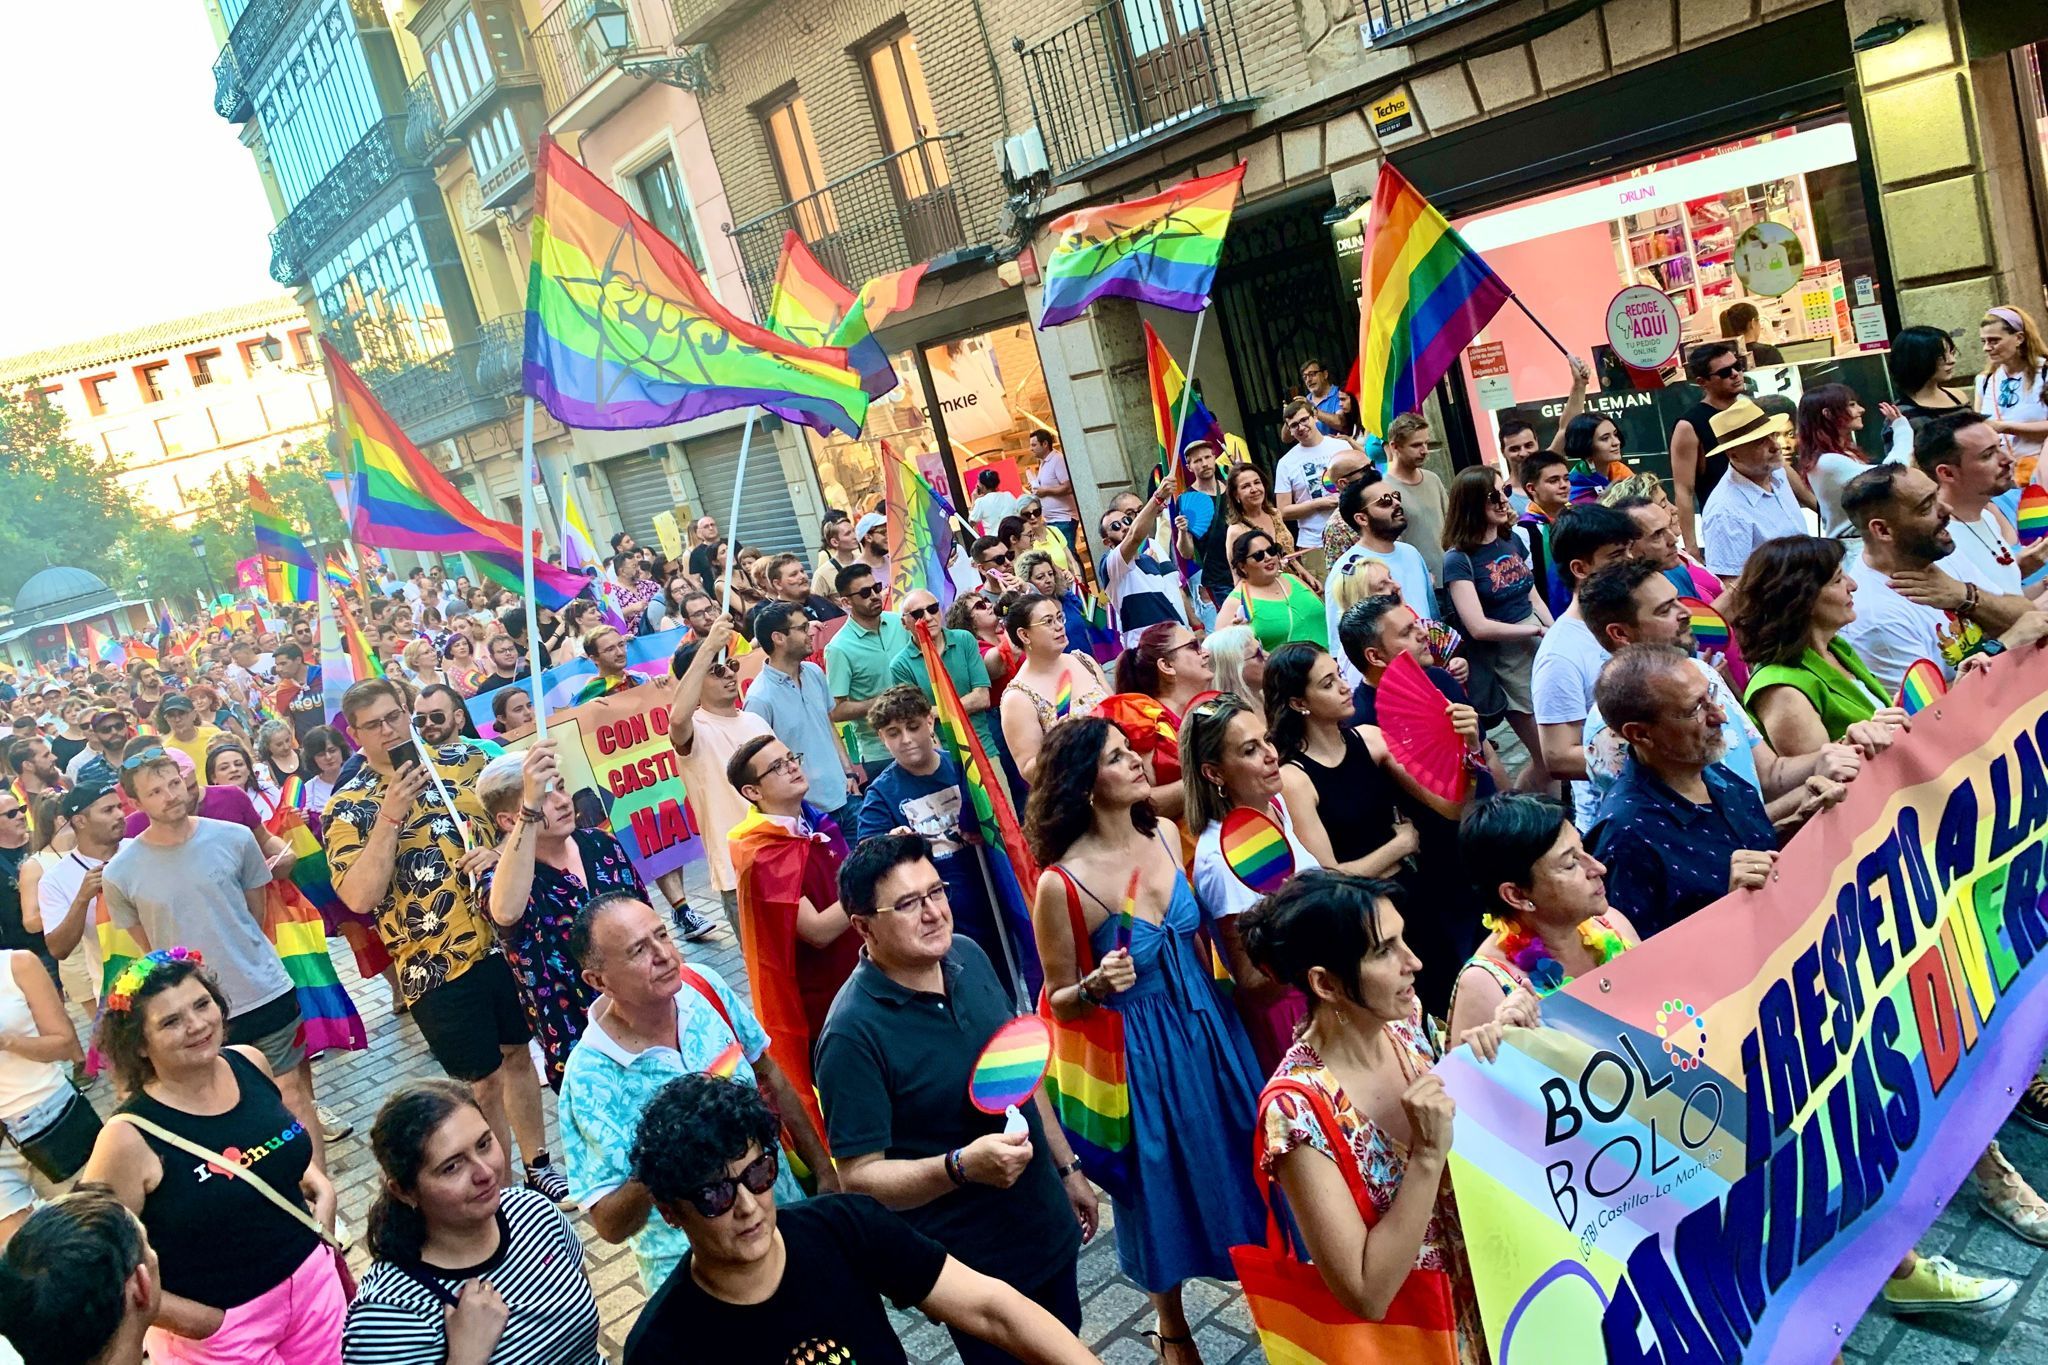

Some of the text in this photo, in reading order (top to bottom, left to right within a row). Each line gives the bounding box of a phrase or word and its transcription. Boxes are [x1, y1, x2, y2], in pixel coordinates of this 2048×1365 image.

[1618, 185, 1656, 204] DRUNI
[1625, 301, 1660, 317] RECOGE
[1634, 309, 1668, 339] AQUÍ
[1633, 347, 1658, 356] ONLINE
[1636, 338, 1661, 348] PEDIDO
[1541, 392, 1652, 418] GELEMAN
[596, 712, 650, 756] CON
[1935, 776, 1978, 897] A
[1545, 1082, 1724, 1232] BOLO
[193, 1163, 213, 1183] I
[1602, 995, 1921, 1365] FAMILIAS
[1578, 1148, 1724, 1263] LGTBI Castilla-La Mancha
